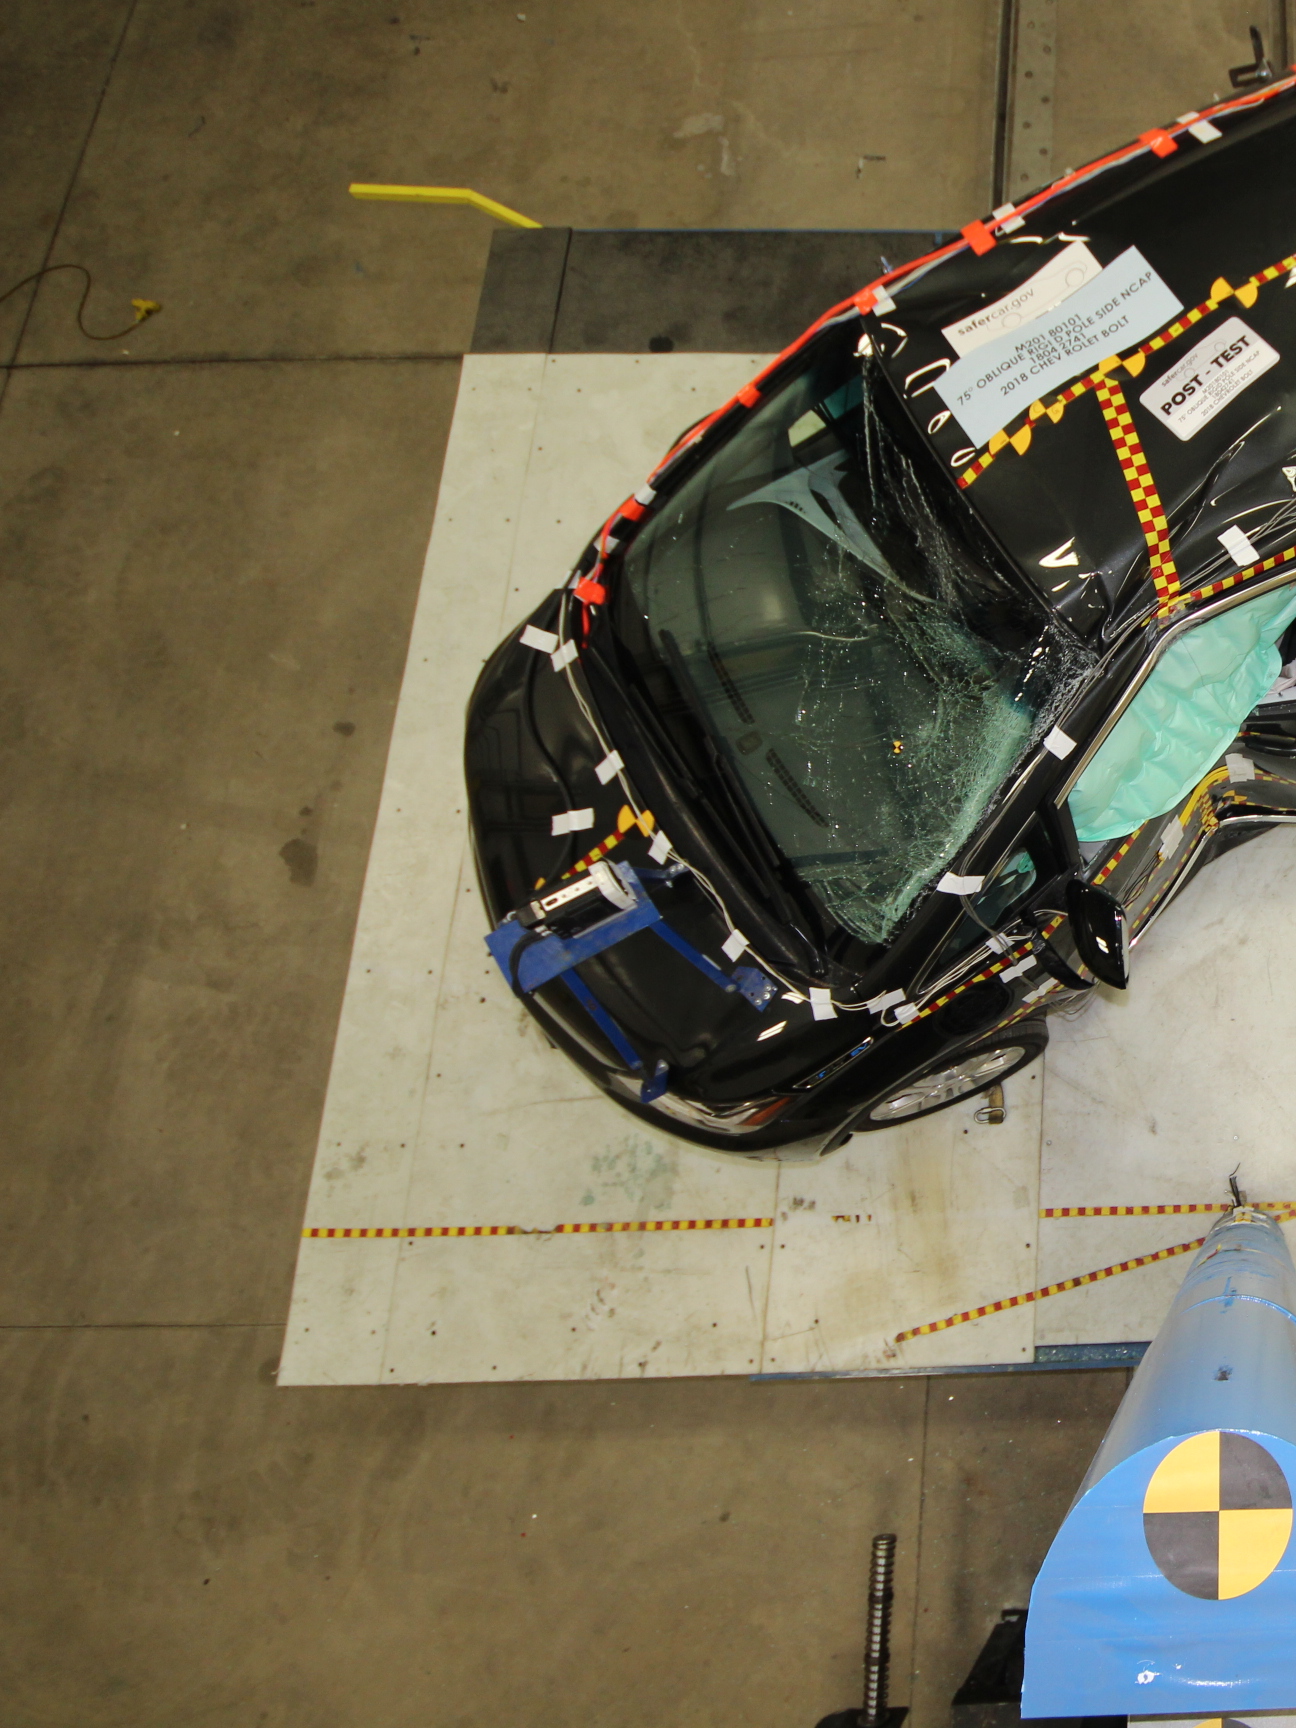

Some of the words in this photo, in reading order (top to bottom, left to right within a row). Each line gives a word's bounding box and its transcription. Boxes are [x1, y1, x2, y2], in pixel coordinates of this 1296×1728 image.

[958, 288, 1034, 336] safercar.gov
[976, 354, 1026, 388] OBLIQUE
[1065, 317, 1095, 337] POLE
[1095, 297, 1120, 320] SIDE
[1120, 272, 1152, 300] NCAP
[1000, 373, 1029, 396] 2018
[1101, 315, 1130, 338] BOLT
[1160, 374, 1203, 416] POST
[1210, 335, 1250, 369] TEST
[1161, 353, 1198, 387] safercar.gov
[1187, 395, 1209, 415] OBLIQUE
[1208, 381, 1223, 398] RIGID
[1222, 370, 1237, 385] POLE
[1235, 361, 1248, 374] SIDE
[1243, 351, 1260, 367] NCAP
[1201, 404, 1214, 417] 2018
[1213, 380, 1241, 406] CHEVROLET
[1240, 369, 1254, 382] BOLT
